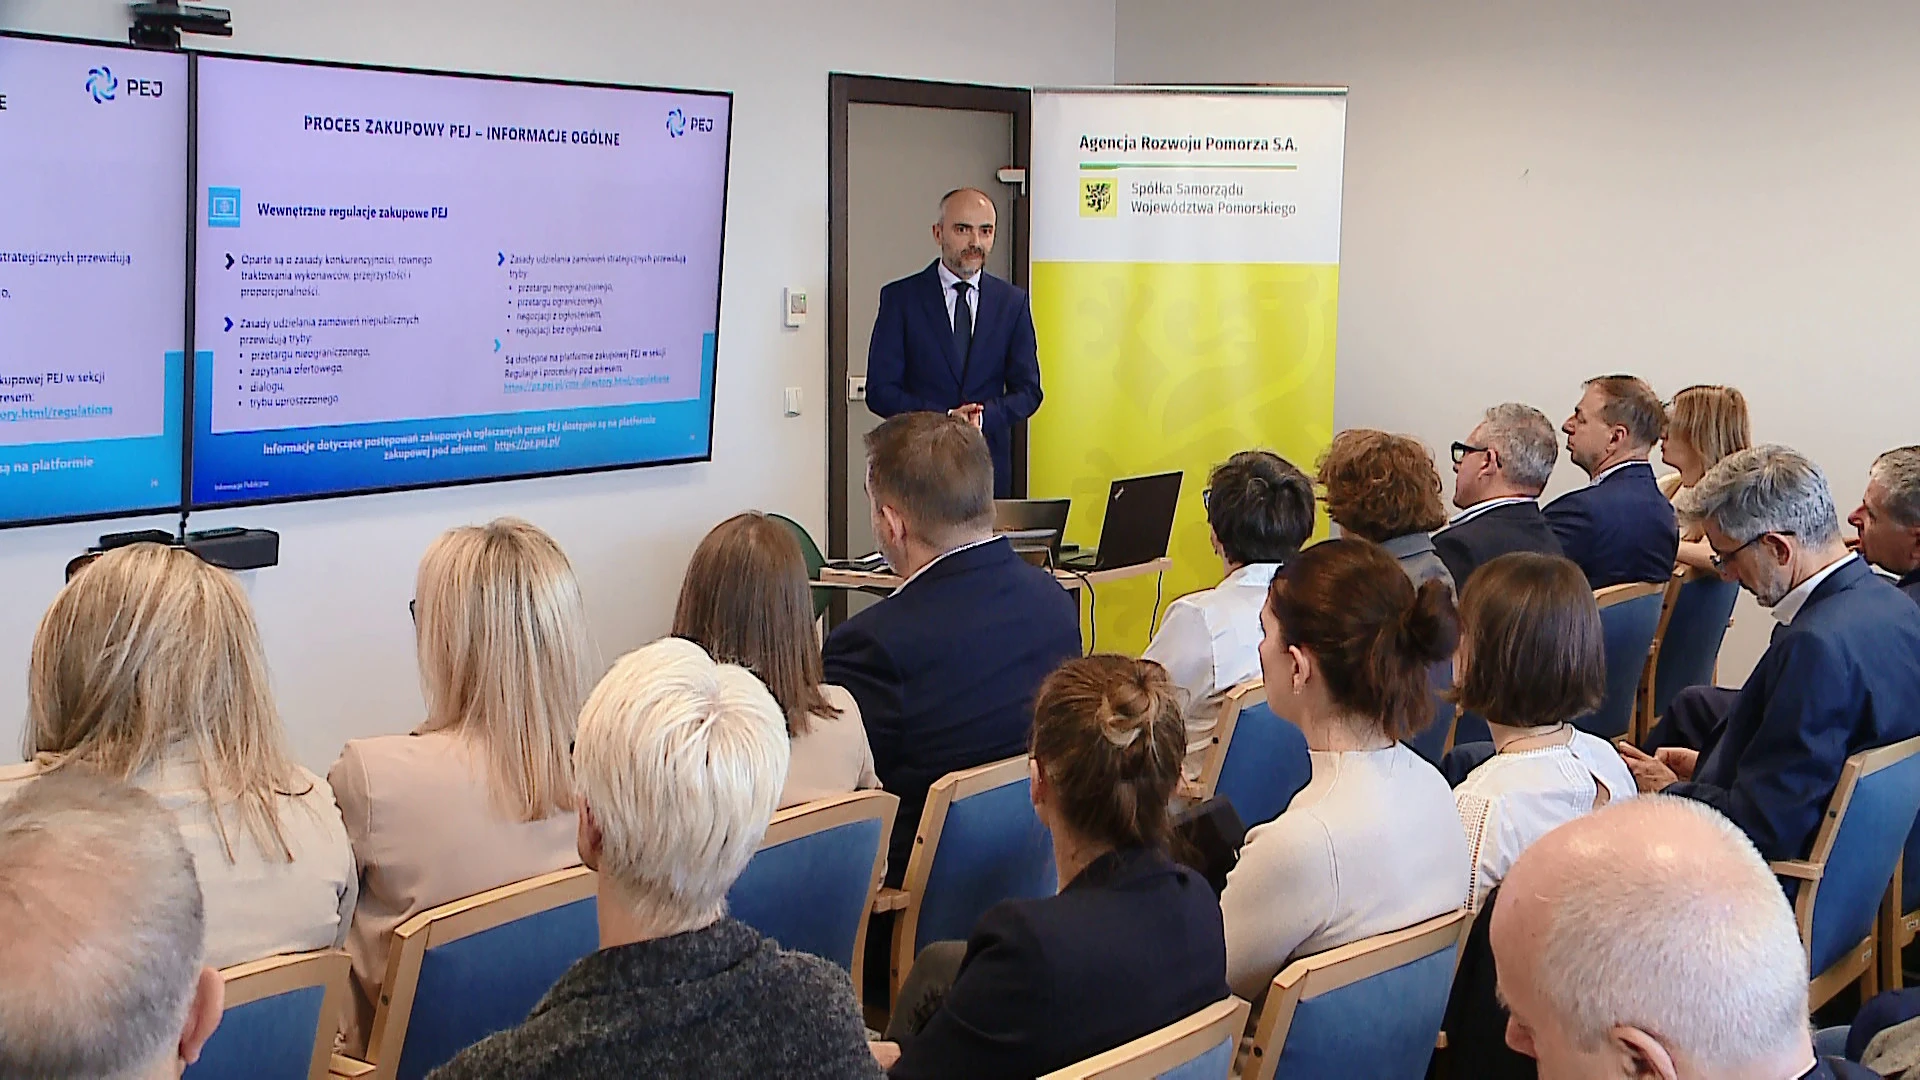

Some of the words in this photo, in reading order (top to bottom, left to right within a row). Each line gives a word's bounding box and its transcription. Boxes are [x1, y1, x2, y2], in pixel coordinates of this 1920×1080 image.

[127, 79, 163, 97] PEJ
[304, 115, 360, 132] PROCES
[365, 119, 445, 136] ZAKUPOWY
[449, 124, 471, 138] PEJ
[487, 125, 567, 143] INFORMACJE
[571, 129, 620, 146] OGÓLNE
[690, 117, 713, 133] PEJ
[1079, 135, 1137, 152] Agencja
[1141, 135, 1202, 153] Rozwoju
[1206, 136, 1269, 151] Pomorza
[1272, 137, 1298, 152] S.A.
[1131, 182, 1173, 197] Spółka
[1176, 182, 1244, 198] Samorządu
[258, 203, 326, 219] Wewnętrzne
[329, 205, 377, 220] regulacje
[379, 205, 429, 221] zakupowe
[432, 207, 448, 219] PEJ
[1130, 200, 1214, 216] Województwa
[1218, 201, 1296, 218] Pomorskiego
[77, 252, 131, 266] przewidują
[241, 254, 272, 267] Oparte
[275, 256, 284, 266] są
[295, 253, 322, 267] zasady
[241, 269, 292, 280] traktowania
[240, 318, 270, 330] Zasady
[273, 316, 316, 329] udzielania
[239, 334, 286, 346] przewidują
[251, 350, 293, 362] przetargu
[47, 372, 64, 384] PEJ
[66, 374, 75, 383] w
[78, 371, 105, 384] sekcji
[250, 365, 292, 378] zapytania
[250, 397, 273, 409] trybu
[263, 439, 315, 456] Informacje
[317, 436, 363, 453] dotyczące
[420, 428, 472, 444] zakupowych
[384, 444, 430, 461] zakupowej
[431, 443, 449, 458] pod
[13, 462, 29, 473] na
[32, 456, 95, 474] platformie
